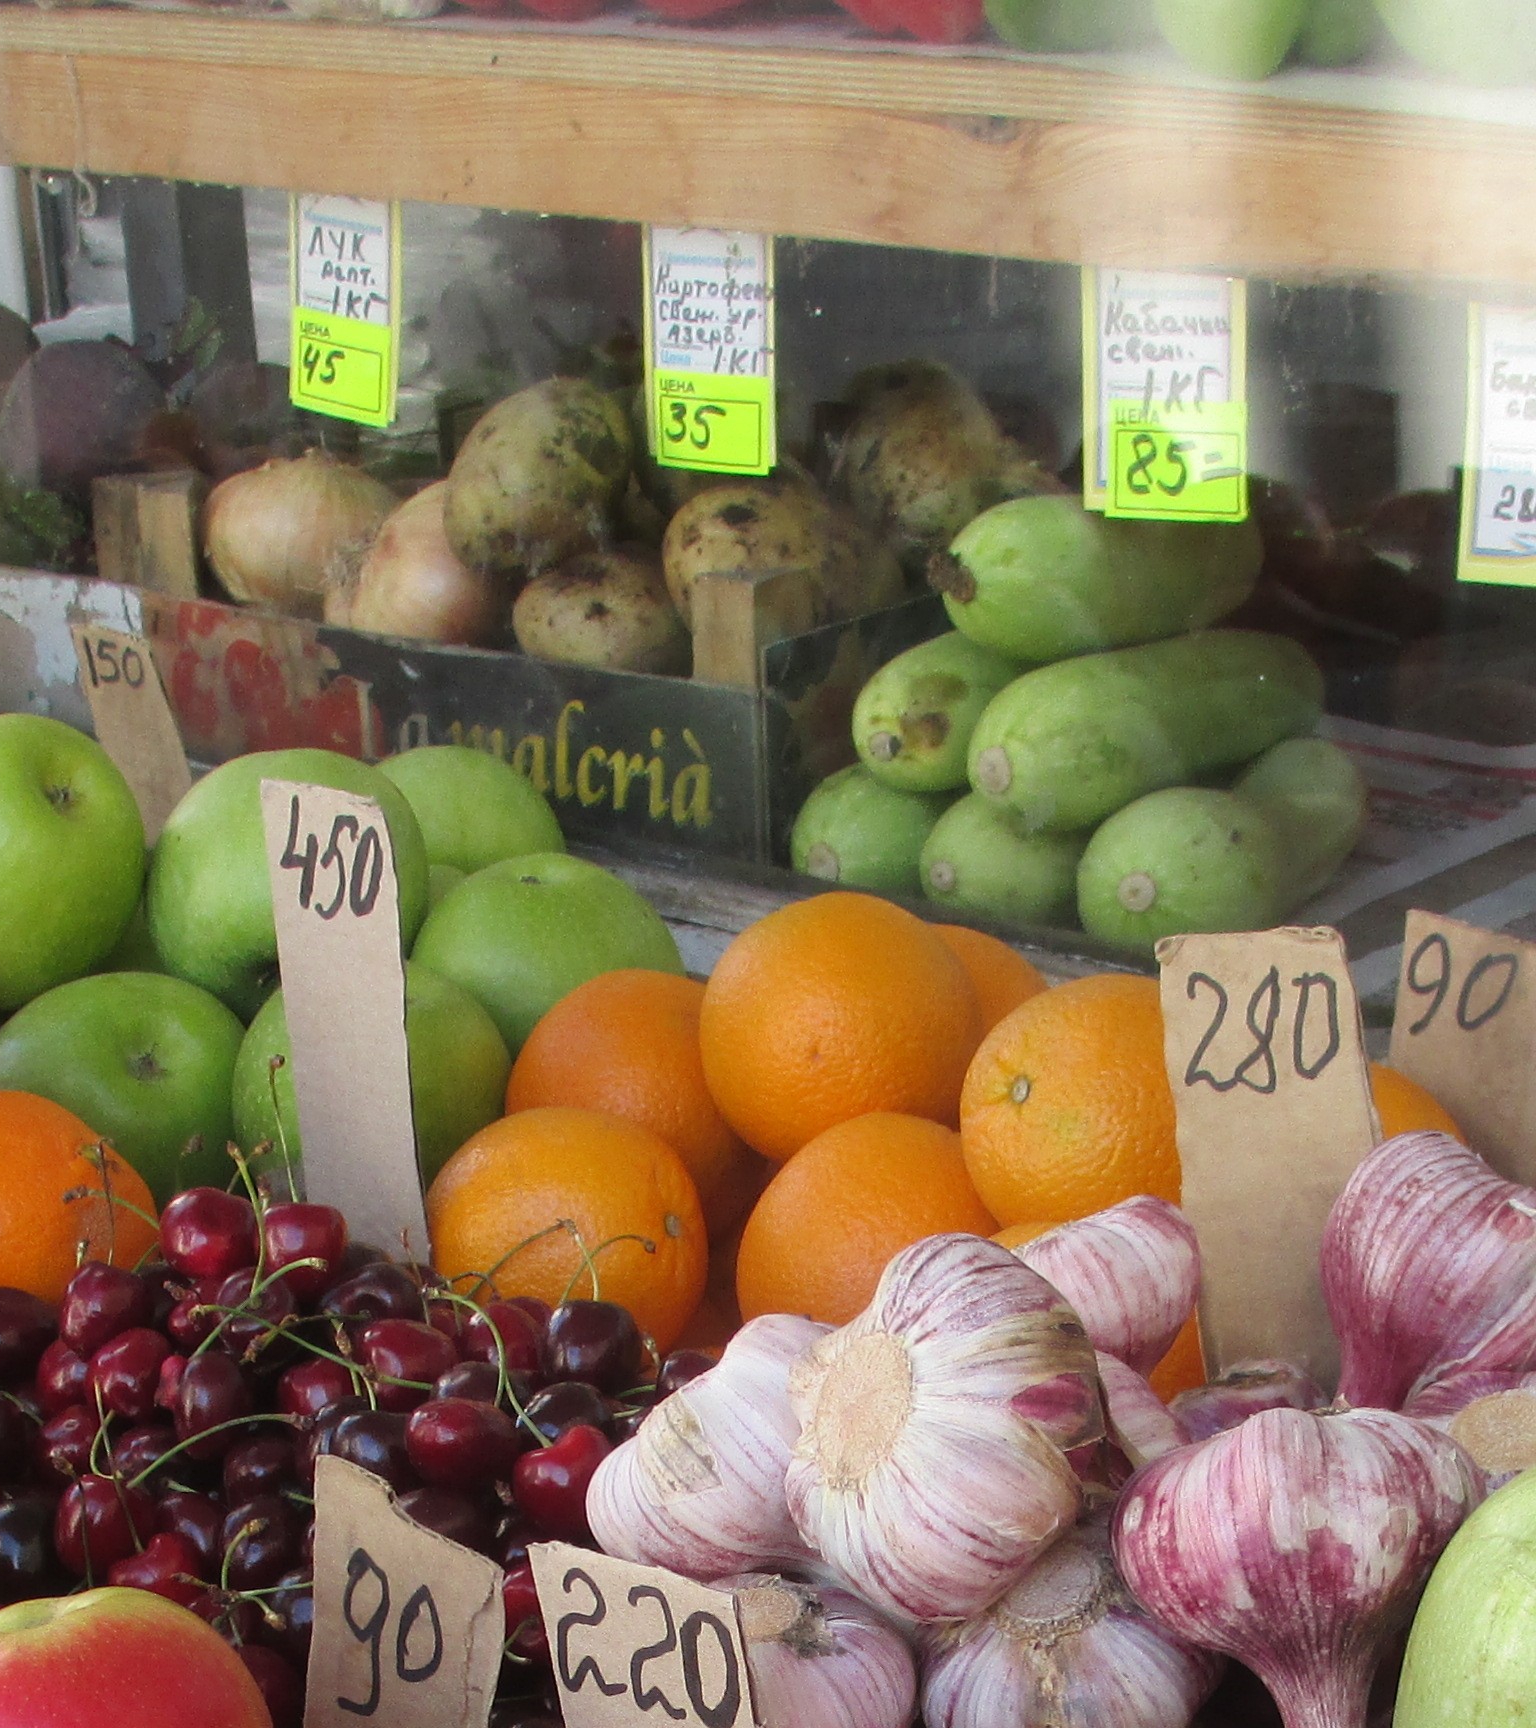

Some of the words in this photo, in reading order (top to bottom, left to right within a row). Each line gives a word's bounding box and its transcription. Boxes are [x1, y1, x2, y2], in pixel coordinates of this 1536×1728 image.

[300, 321, 331, 339] ЦЕНА
[303, 343, 345, 384] 45
[659, 378, 695, 394] ЦЕНА
[665, 402, 727, 450] 35
[1115, 406, 1160, 427] ЦЕНА
[82, 636, 145, 688] 150
[280, 794, 384, 921] 450
[1406, 932, 1519, 1036] 90
[1184, 964, 1340, 1095] 280
[337, 1546, 443, 1718] 90
